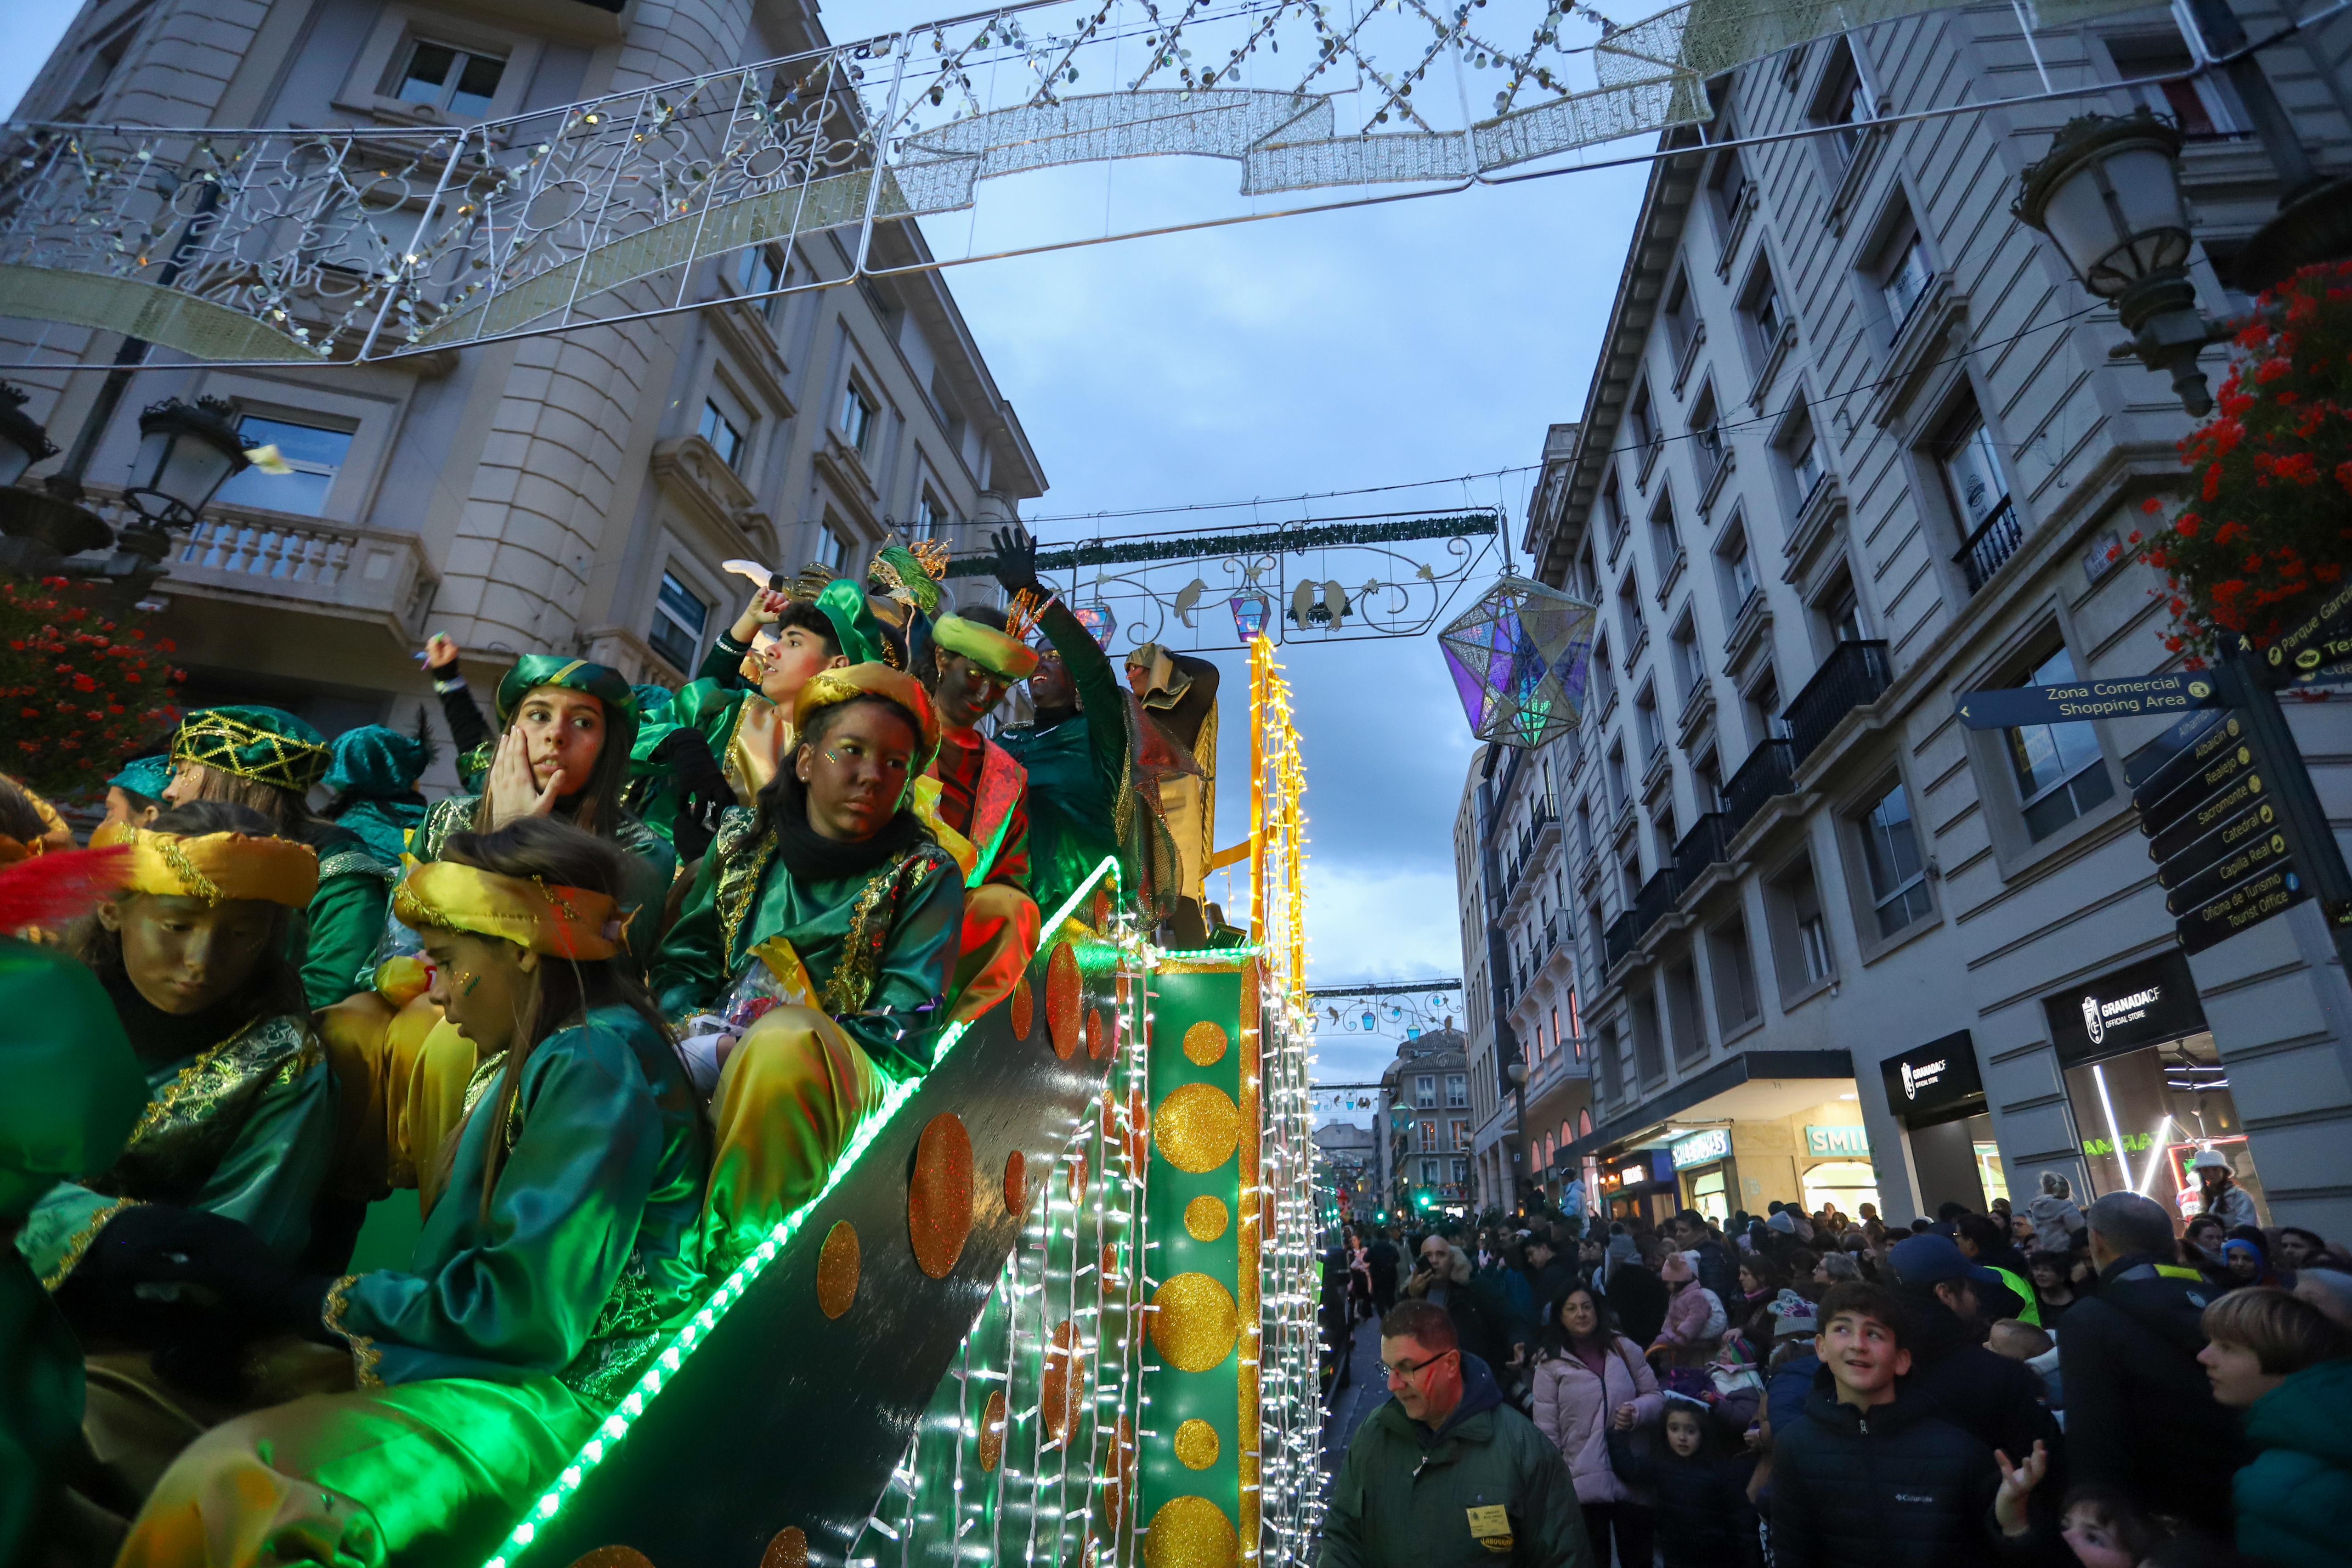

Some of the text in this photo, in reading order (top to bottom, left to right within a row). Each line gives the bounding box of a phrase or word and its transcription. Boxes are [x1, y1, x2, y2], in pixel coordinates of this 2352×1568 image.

[2281, 617, 2319, 652] Parque
[2046, 677, 2181, 700] Zona Comercial
[2059, 695, 2186, 716] Shopping Area
[2205, 758, 2237, 784] Realejo
[2198, 785, 2248, 824] Sacromonte
[2222, 812, 2260, 843] Catedral
[2220, 841, 2271, 879] Capilla Real
[2202, 874, 2281, 921] Oficina de Turismo
[2227, 891, 2288, 927] Tourist Office
[2105, 1009, 2146, 1029] OFFICIAL STORE
[1915, 1076, 1939, 1089] OFFICIAL STORE
